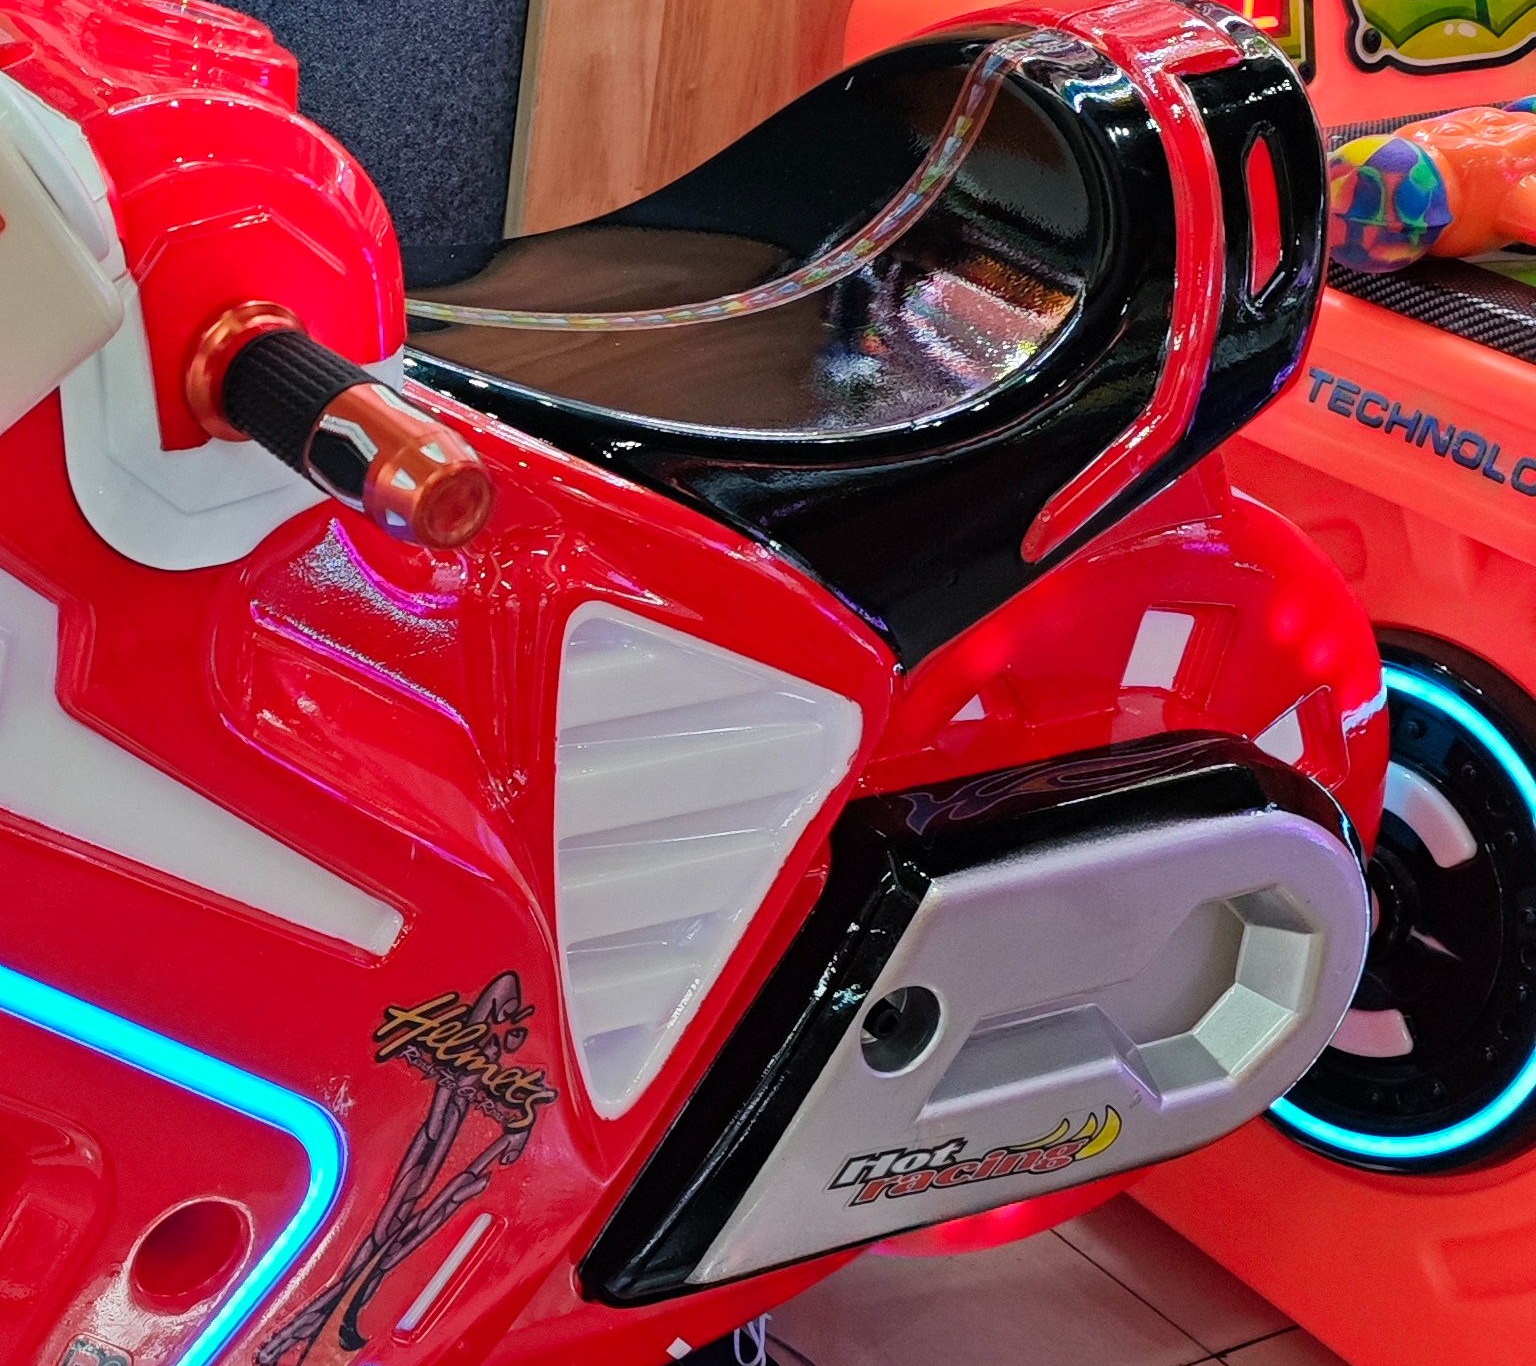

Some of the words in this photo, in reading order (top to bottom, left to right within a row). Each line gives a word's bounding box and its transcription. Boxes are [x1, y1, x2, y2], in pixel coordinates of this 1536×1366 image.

[1308, 366, 1536, 497] TECHNOLO
[375, 992, 556, 1129] Helmets
[831, 1137, 967, 1188] Hot
[852, 1138, 1089, 1205] racing
